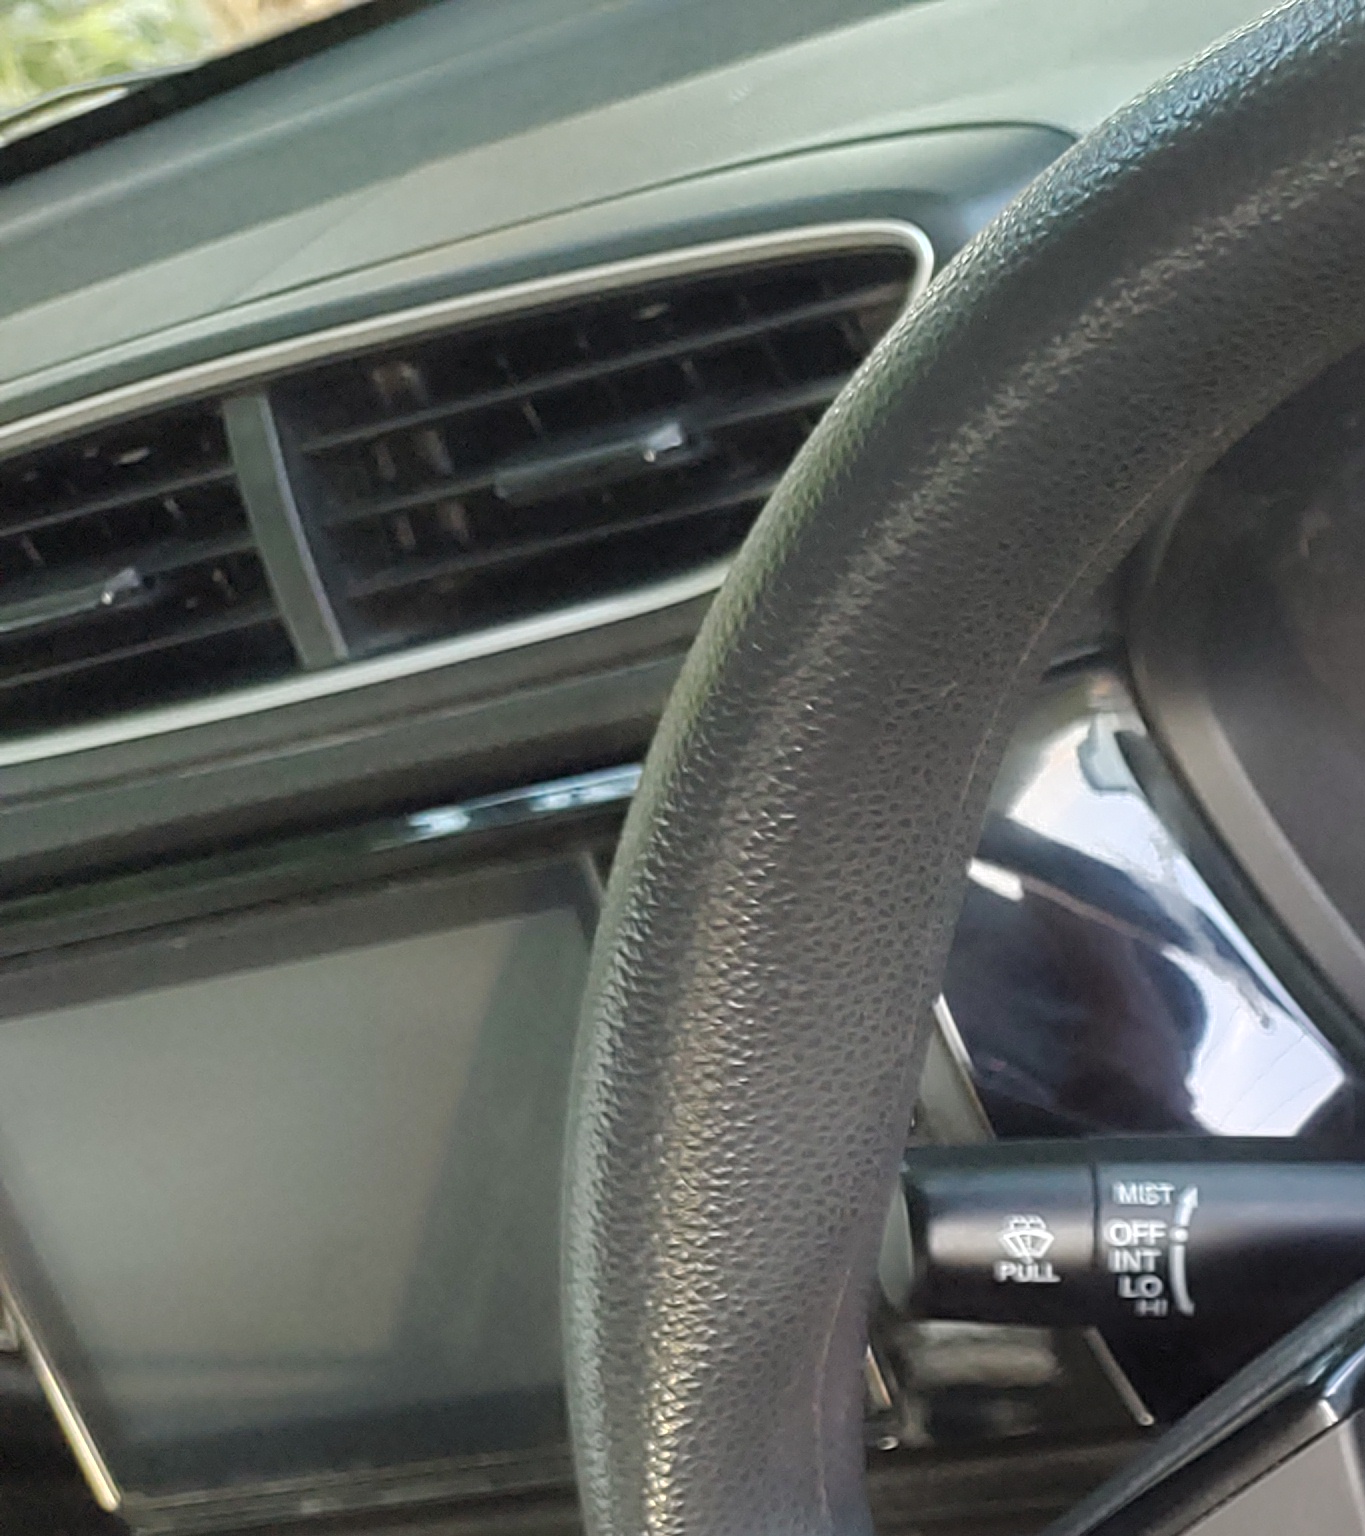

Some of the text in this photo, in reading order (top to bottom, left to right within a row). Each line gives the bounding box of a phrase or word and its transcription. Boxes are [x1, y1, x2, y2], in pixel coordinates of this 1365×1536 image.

[1113, 1181, 1175, 1206] MIST
[1104, 1217, 1168, 1246] OFF
[993, 1259, 1062, 1284] PULL
[1108, 1247, 1163, 1273] INT
[1118, 1274, 1165, 1299] LO
